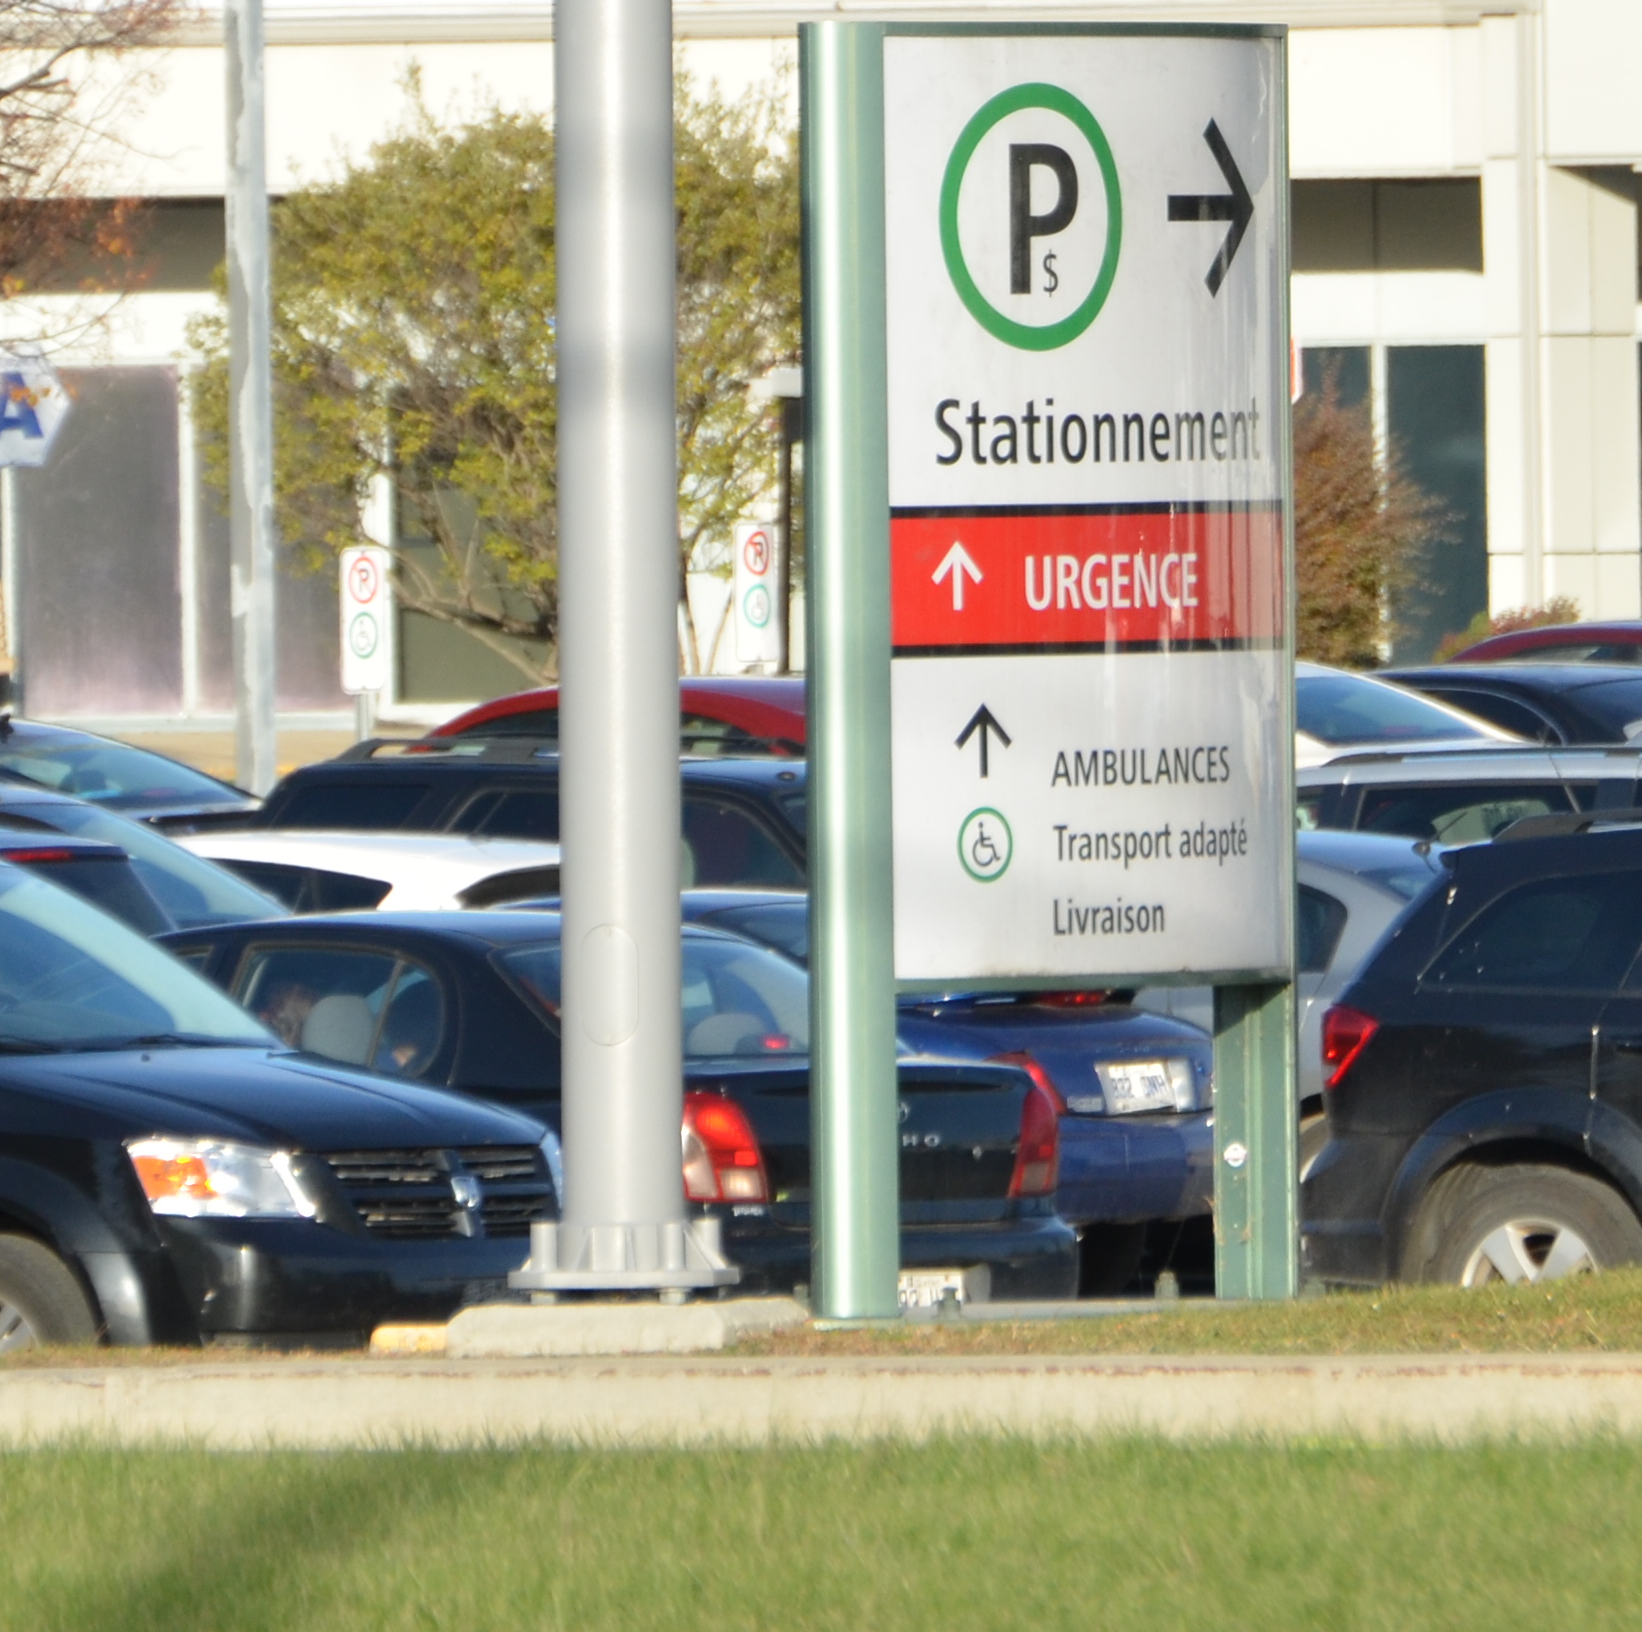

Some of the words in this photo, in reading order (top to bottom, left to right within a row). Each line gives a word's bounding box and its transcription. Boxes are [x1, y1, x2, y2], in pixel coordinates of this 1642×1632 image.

[1009, 143, 1079, 295] P
[934, 397, 1261, 466] Stationnement
[1024, 552, 1199, 611] URGENCE
[1051, 745, 1231, 788] AMBULANCES
[1052, 822, 1173, 871] Transport
[1179, 817, 1248, 868] adapté
[1052, 896, 1166, 937] Livraison
